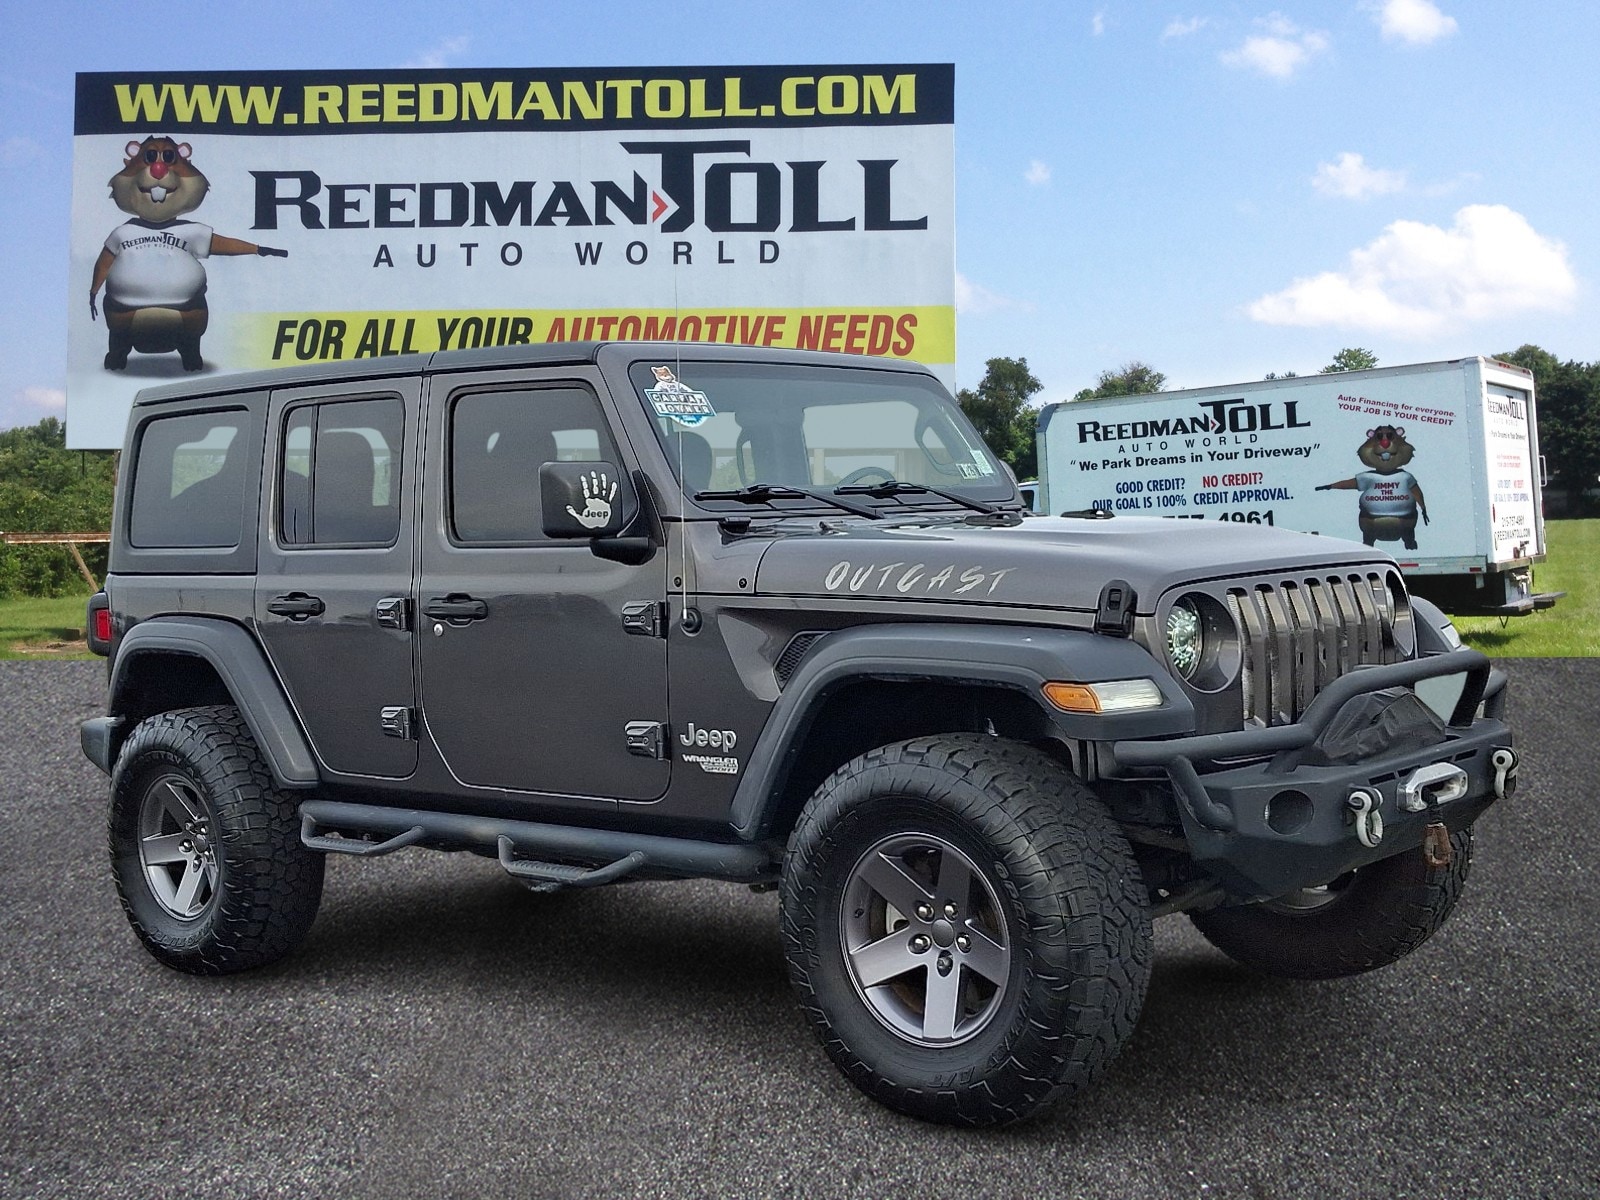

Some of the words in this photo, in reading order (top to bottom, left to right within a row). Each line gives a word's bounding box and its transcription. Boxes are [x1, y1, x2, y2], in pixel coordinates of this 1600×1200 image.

[114, 74, 917, 124] WWW.REEDMANTOLL.COM
[373, 241, 523, 268] AUTO
[575, 240, 781, 266] WORLD
[272, 318, 347, 360] FOR
[354, 318, 419, 358] ALL
[437, 317, 533, 352] YOUR
[545, 315, 786, 347] AUTOMOTIVE
[795, 313, 918, 356] NEEDS
[1337, 394, 1356, 403] Auto
[1358, 396, 1399, 411] Financing
[1401, 403, 1413, 411] for
[1415, 406, 1457, 419] everyone.
[1338, 403, 1361, 412] YOUR
[1363, 406, 1381, 414] JOB
[1393, 410, 1418, 421] YOUR
[1420, 414, 1454, 425] CREDIT
[1118, 441, 1168, 453] AUTO
[1185, 433, 1258, 448] WORLD
[1102, 457, 1132, 470] Park
[1135, 454, 1186, 467] Dreams
[1190, 453, 1203, 463] in
[1207, 450, 1239, 462] Your
[1115, 480, 1143, 494] GOOD
[1146, 477, 1186, 493] CREDIT?
[1202, 475, 1219, 488] NO
[1221, 472, 1263, 487] CREDIT?
[1092, 499, 1113, 511] OUR
[1116, 497, 1141, 510] GOAL
[1143, 497, 1152, 509] IS
[1156, 494, 1187, 508] 100%
[1193, 491, 1229, 506] CREDIT
[1232, 488, 1294, 503] APPROVAL.
[584, 509, 609, 519] Jeep
[824, 561, 1018, 597] OUTCAST
[680, 723, 737, 753] Jeep
